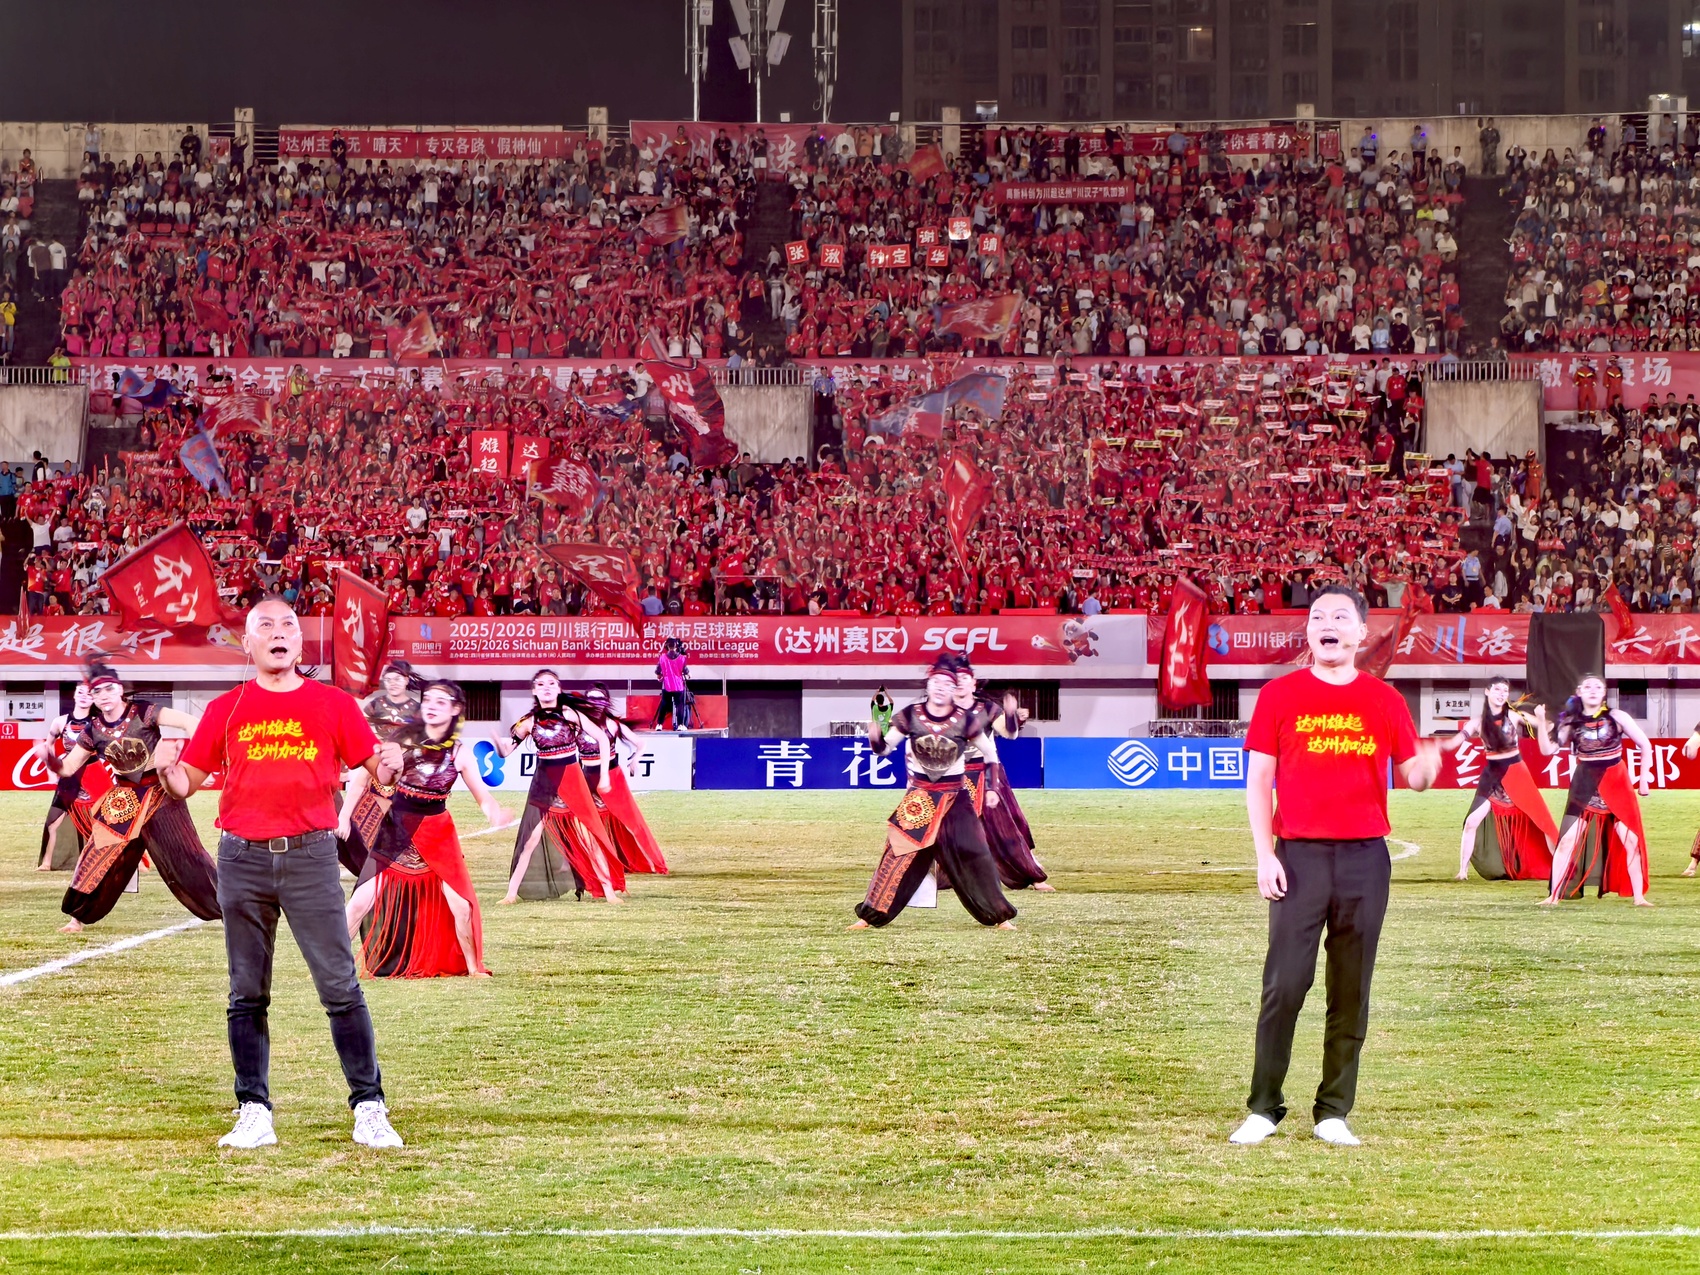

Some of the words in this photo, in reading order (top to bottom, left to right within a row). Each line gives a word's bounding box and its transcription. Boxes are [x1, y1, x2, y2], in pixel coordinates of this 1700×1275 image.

[919, 230, 935, 244] 谢
[789, 246, 804, 260] 张
[892, 249, 907, 264] 定
[931, 249, 945, 263] 华
[478, 437, 501, 473] 雄起
[450, 622, 536, 639] 2025/2026
[919, 627, 1008, 653] SCFL
[450, 639, 510, 652] 2025/2026
[513, 639, 559, 650] Sichuan
[561, 639, 591, 650] Bank
[595, 639, 640, 650] Sichuan
[642, 639, 666, 652] City
[718, 639, 759, 653] League
[238, 718, 304, 742] 达州雄起
[1295, 714, 1364, 733] 达州雄起
[247, 740, 318, 761] 达州加油
[1307, 736, 1377, 756] 达州加油
[1168, 746, 1244, 781] 中国
